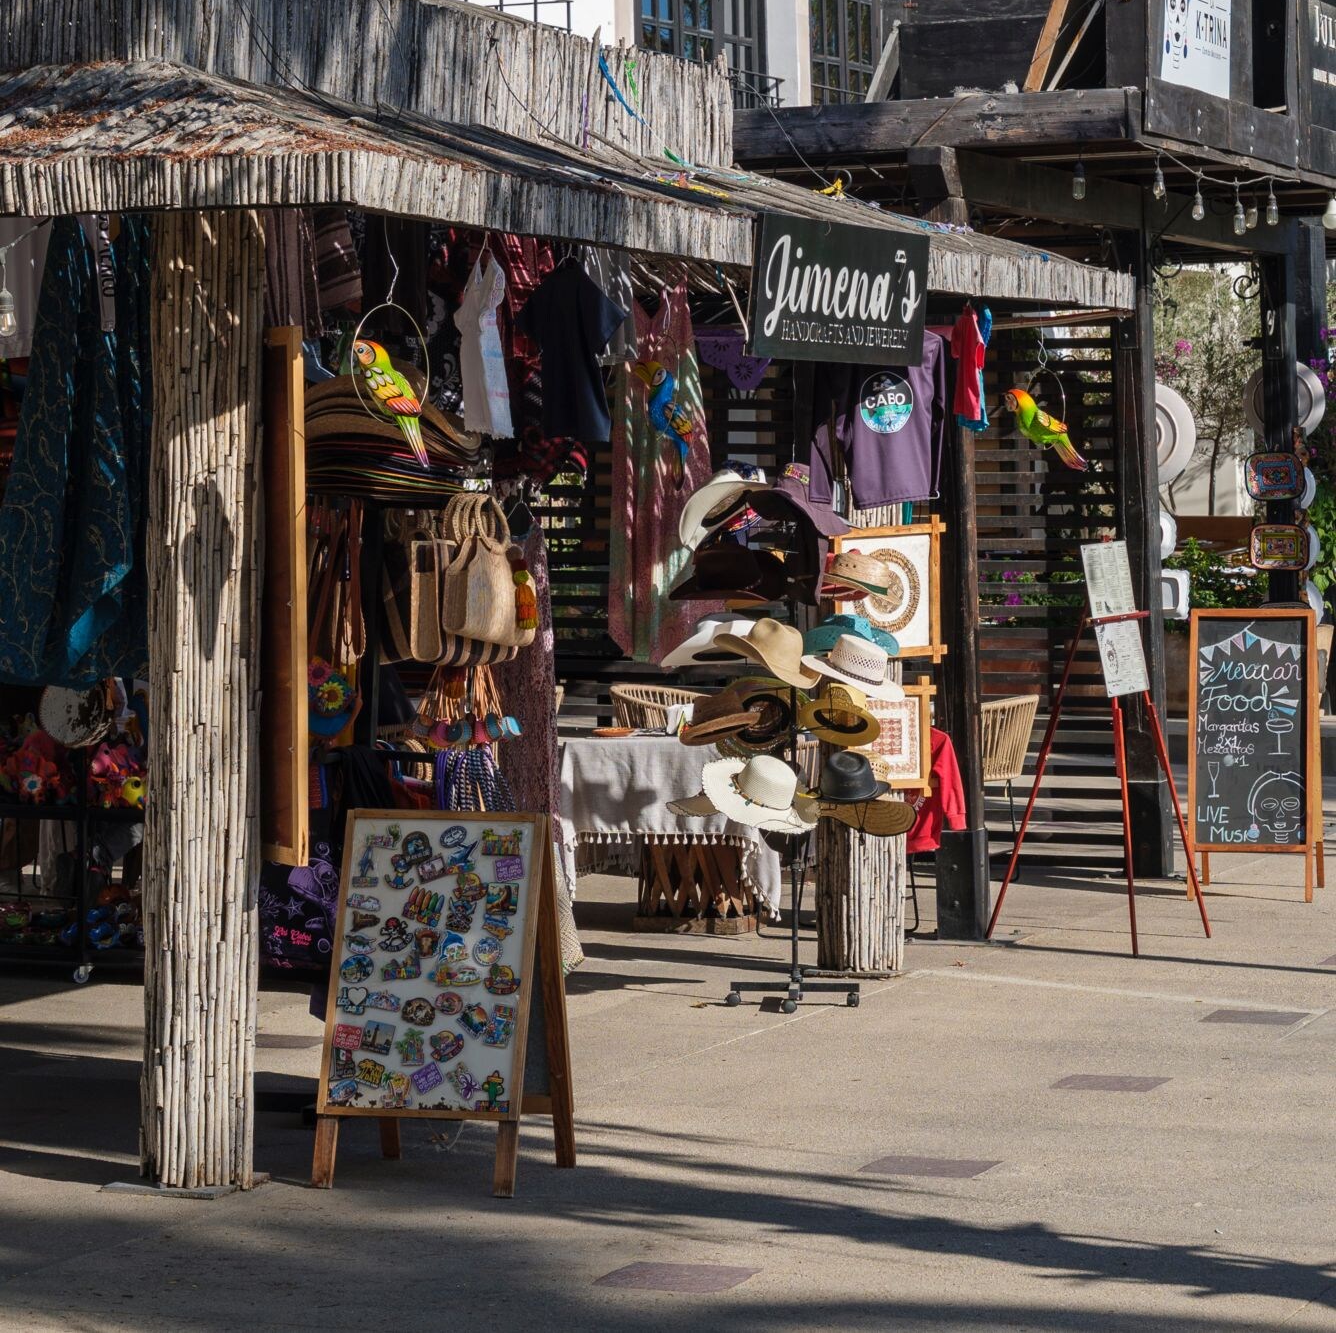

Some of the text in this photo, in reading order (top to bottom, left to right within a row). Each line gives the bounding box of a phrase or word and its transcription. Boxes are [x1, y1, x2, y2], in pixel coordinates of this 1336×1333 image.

[1313, 5, 1336, 49] JUL
[763, 233, 922, 338] Jimena's
[780, 318, 844, 345] HANDCRAFTS
[844, 324, 865, 346] AND
[865, 392, 906, 409] CABO
[1209, 661, 1303, 683] Mexican
[1199, 681, 1273, 713] Food
[1197, 713, 1260, 738] Margaritas
[1197, 805, 1231, 824] LIVE
